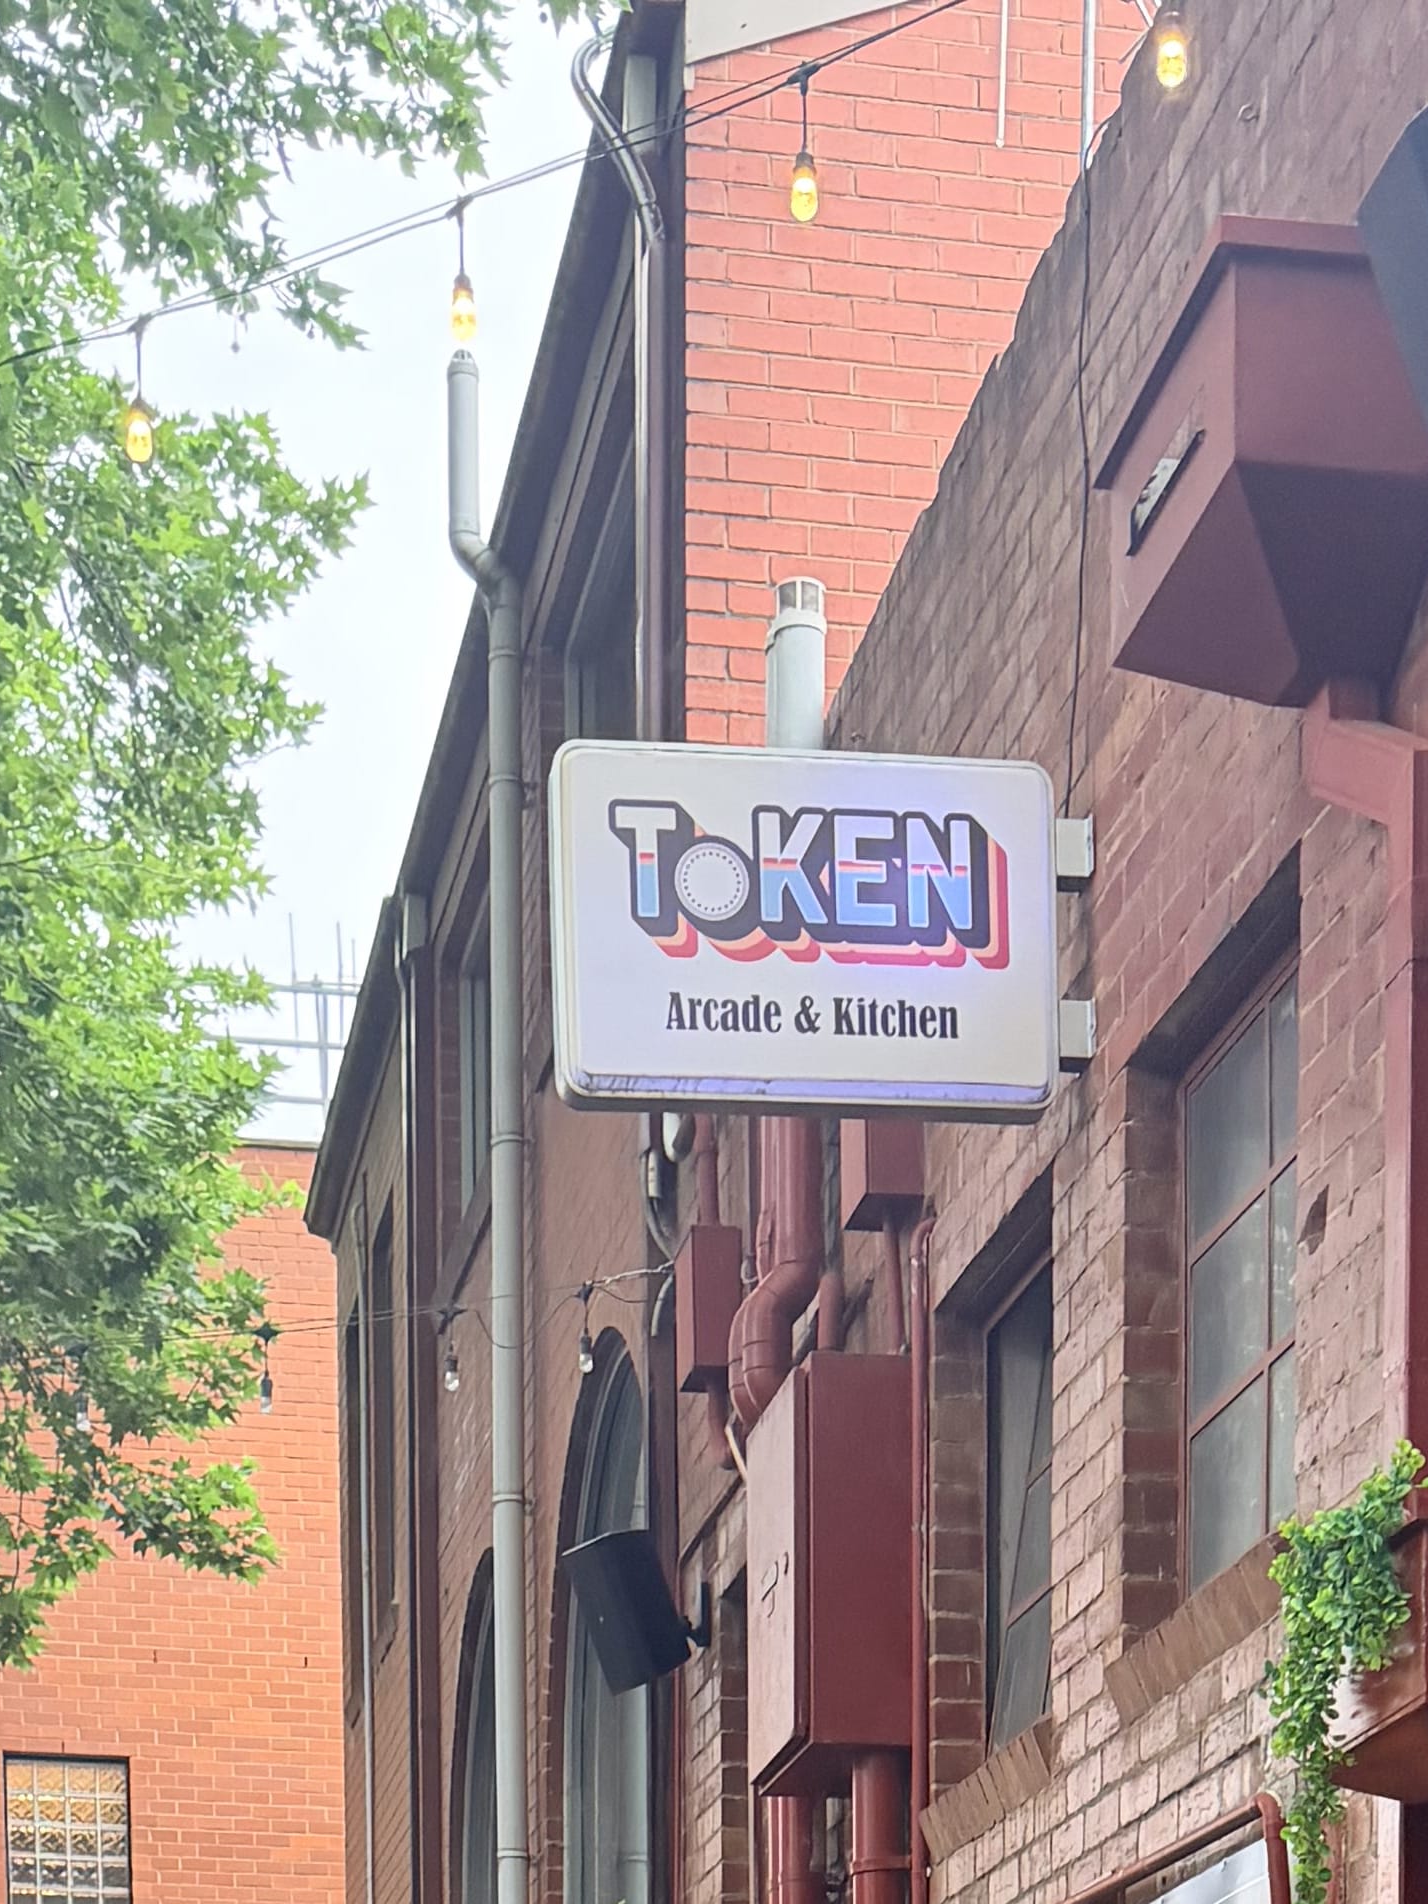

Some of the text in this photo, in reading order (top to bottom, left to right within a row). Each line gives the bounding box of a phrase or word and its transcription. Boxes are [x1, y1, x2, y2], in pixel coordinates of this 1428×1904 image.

[608, 798, 1009, 969] TOKEN
[666, 992, 959, 1040] Arcade & Kitchen
